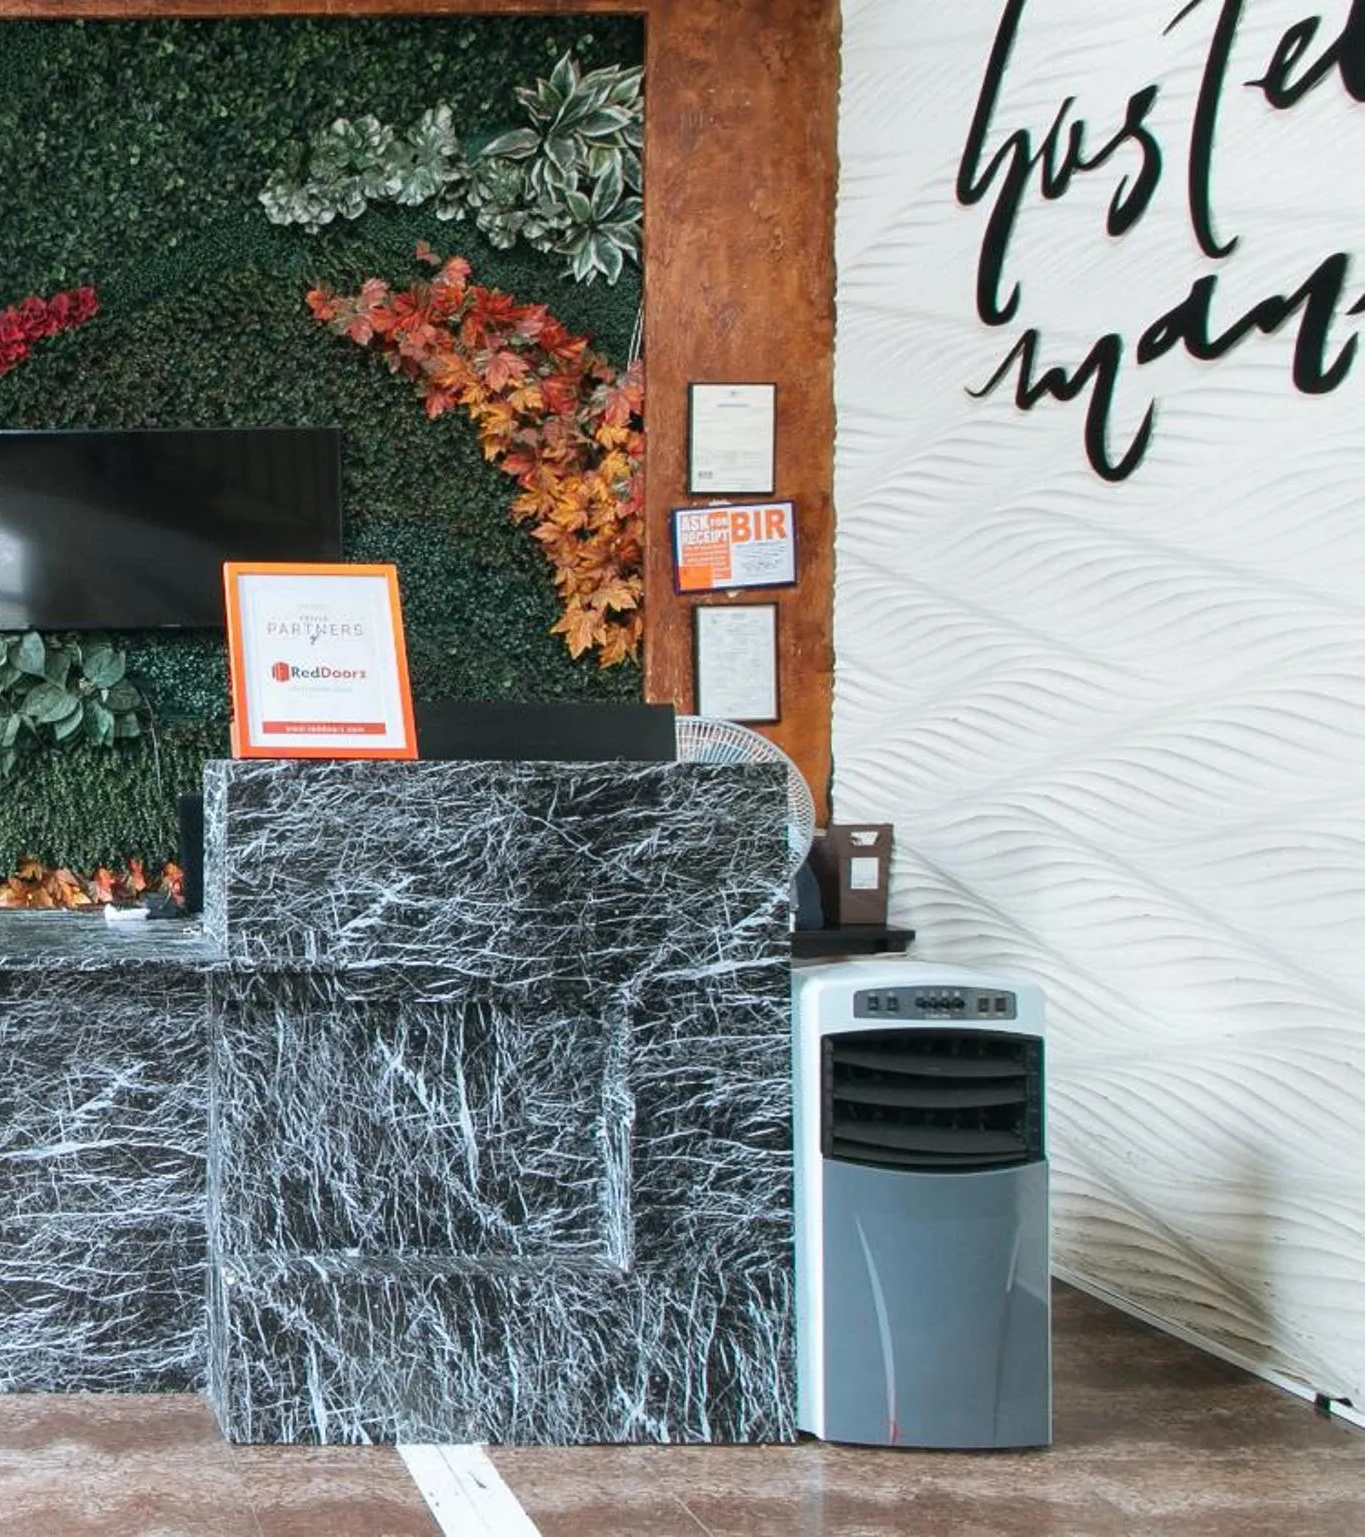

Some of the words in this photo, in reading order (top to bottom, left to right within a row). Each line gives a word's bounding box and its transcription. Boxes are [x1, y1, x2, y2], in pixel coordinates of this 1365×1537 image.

[681, 514, 709, 531] ASK
[731, 509, 787, 544] BIR
[267, 622, 364, 637] PARTNERS
[291, 665, 367, 680] RedDoorz
